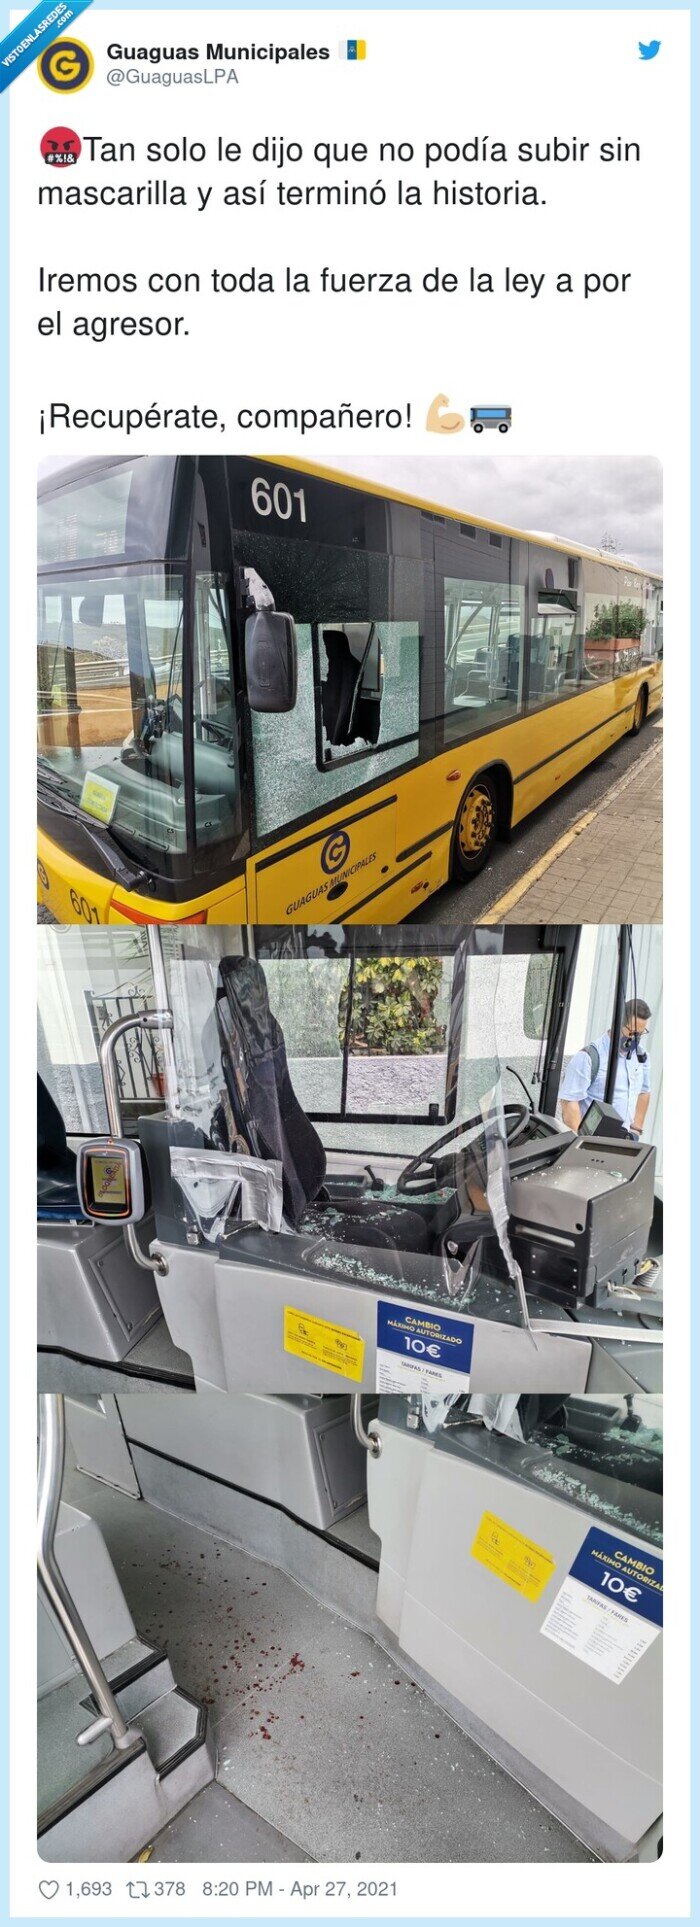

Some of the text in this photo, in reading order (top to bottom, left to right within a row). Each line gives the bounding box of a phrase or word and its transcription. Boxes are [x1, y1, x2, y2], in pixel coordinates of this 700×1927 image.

[252, 477, 306, 522] 601
[286, 852, 377, 915] GUAGUAS MUNICIPALES
[70, 888, 99, 924] 601
[387, 1320, 462, 1345] MÁXIMO AUTORIZADO
[405, 1316, 441, 1332] CAMBIO
[404, 1336, 441, 1359] 10€
[401, 1361, 421, 1372] TARIFAS
[591, 1549, 622, 1569] MÁXIMO
[614, 1551, 655, 1575] CAMBIO
[600, 1572, 642, 1603] 10€
[586, 1595, 607, 1612] TARIFAS
[612, 1609, 629, 1624] FARES
